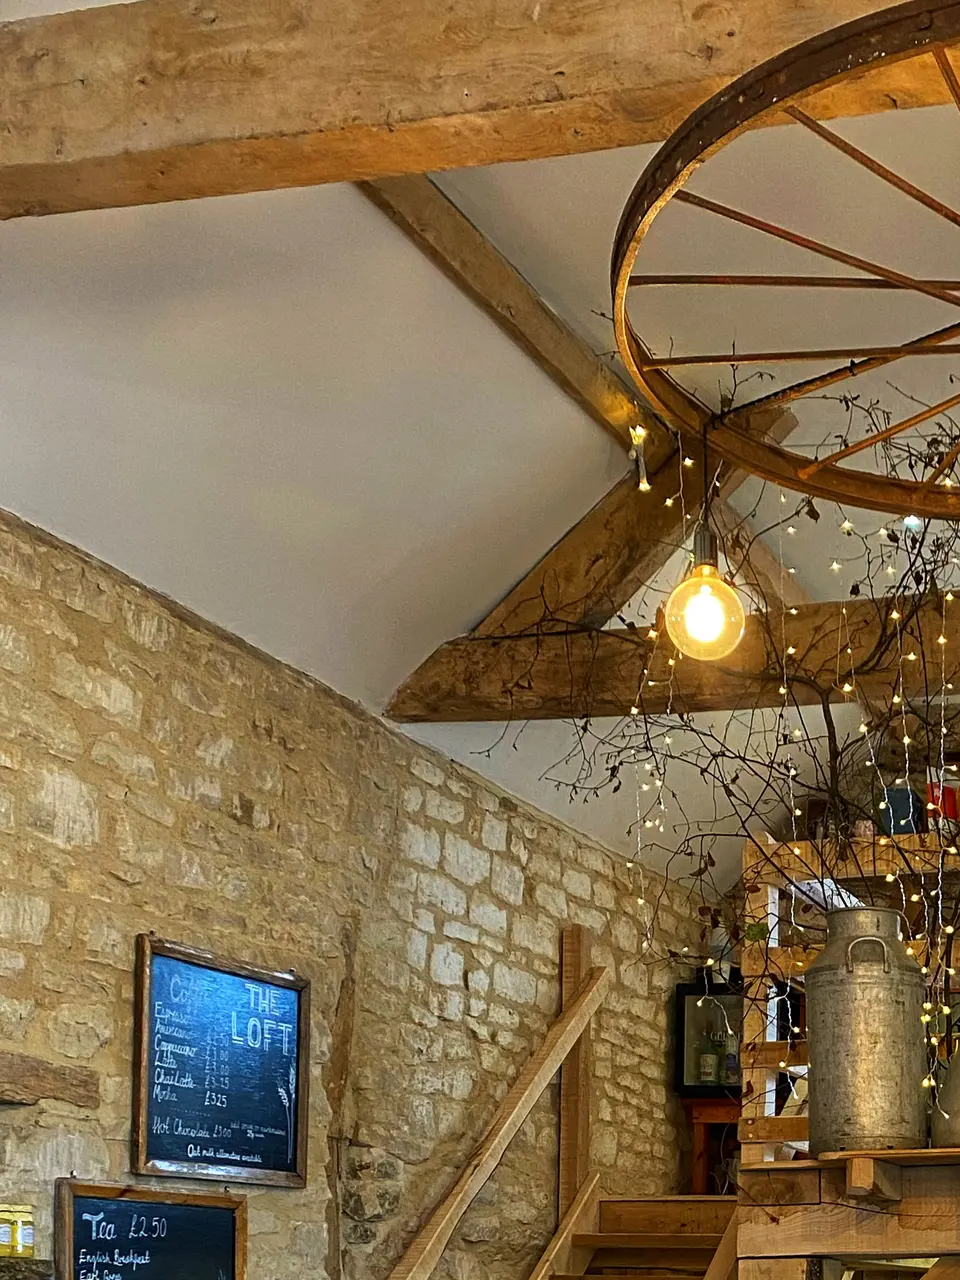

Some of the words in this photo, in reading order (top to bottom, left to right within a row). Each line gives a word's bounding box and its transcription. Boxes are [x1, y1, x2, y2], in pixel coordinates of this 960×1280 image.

[245, 983, 281, 1016] THE
[231, 1011, 293, 1057] LOFT
[152, 1115, 170, 1135] Hot
[82, 1211, 118, 1241] Tea
[79, 1248, 112, 1272] English
[113, 1248, 151, 1272] Breakfast
